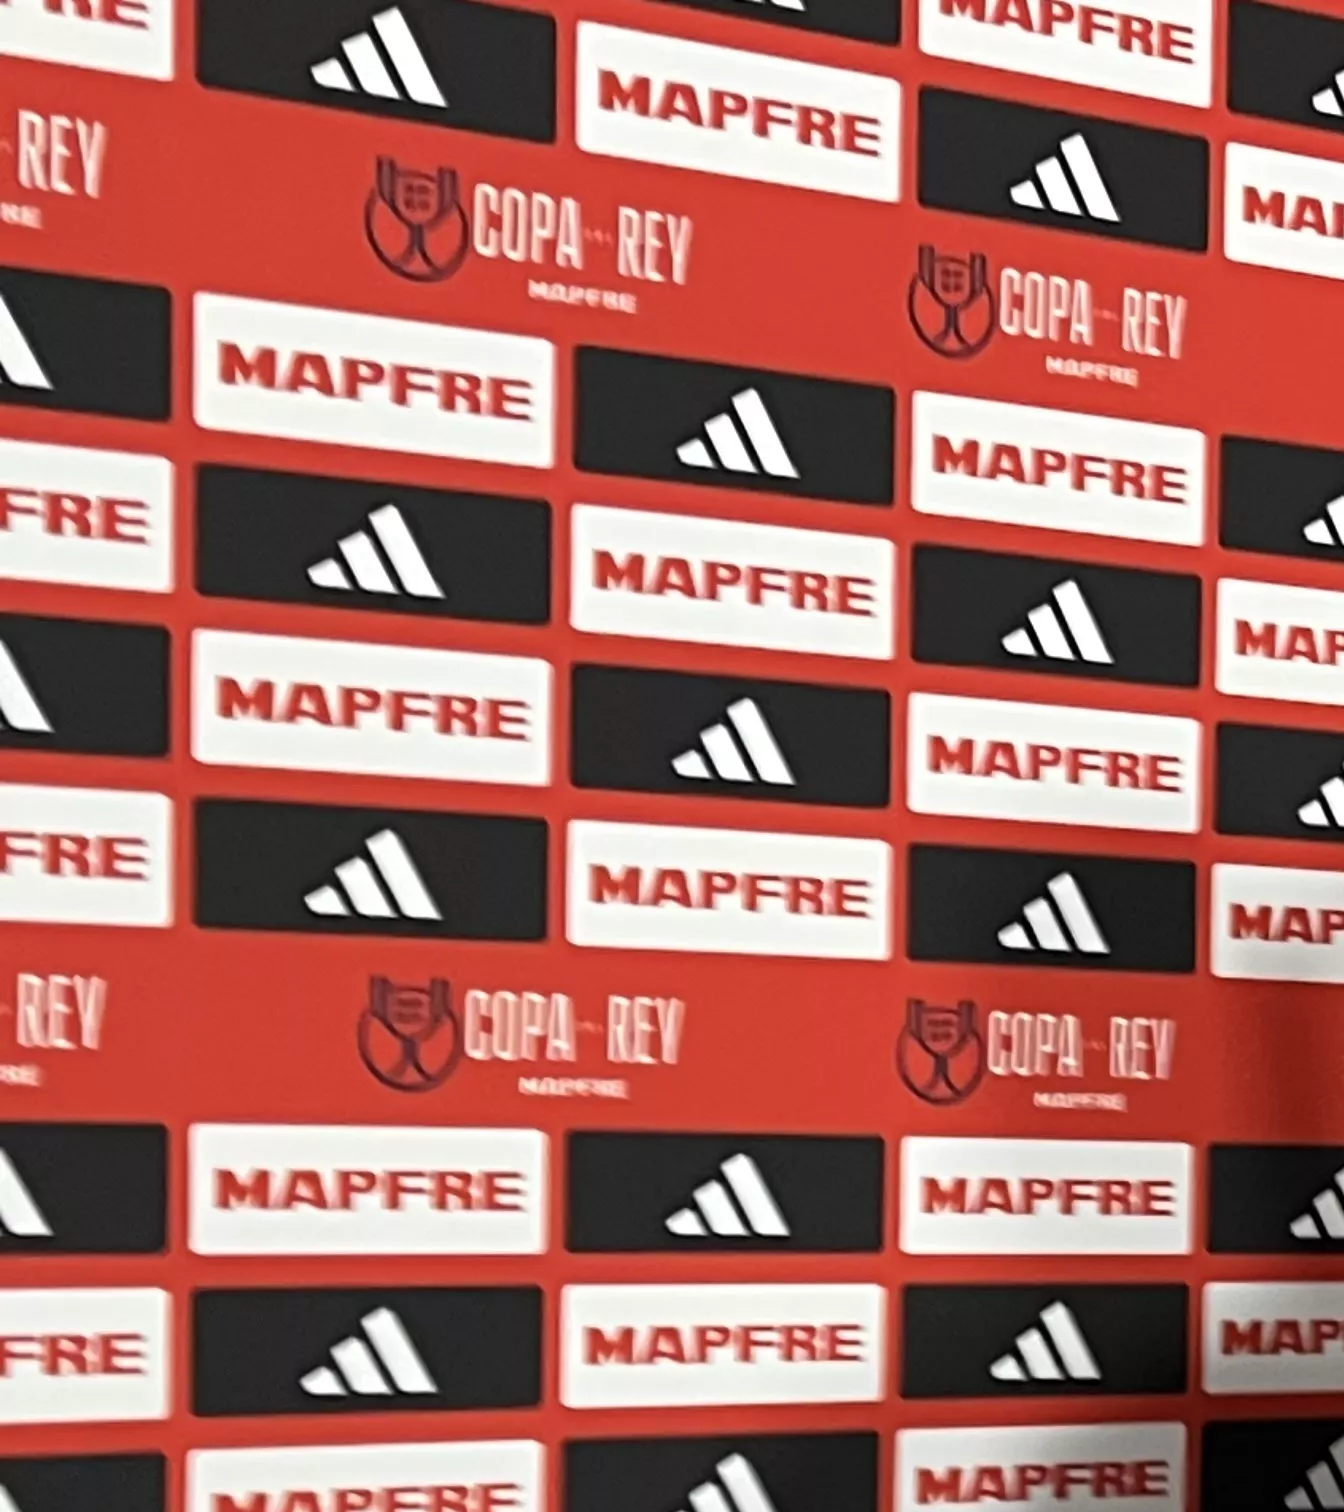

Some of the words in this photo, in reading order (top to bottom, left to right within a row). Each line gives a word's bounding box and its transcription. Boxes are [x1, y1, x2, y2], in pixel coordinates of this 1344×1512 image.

[938, 0, 1194, 64] MAPFRE
[600, 70, 880, 157] MAPFRE
[19, 110, 105, 198] REY
[474, 183, 583, 269] COPA
[618, 206, 692, 285] REY
[528, 280, 636, 313] MAPFRE
[1000, 267, 1092, 345] COPA
[1122, 287, 1186, 359] REY
[219, 342, 531, 421] MAPFRE
[1046, 356, 1138, 387] MAPFRE
[933, 435, 1186, 504] MAPFRE
[0, 487, 147, 544] FRE
[594, 550, 873, 616] MAPFRE
[218, 677, 527, 741] MAPFRE
[929, 736, 1181, 793] MAPFRE
[0, 831, 146, 880] FRE
[590, 865, 868, 918] MAPFRE
[17, 973, 106, 1049] REY
[465, 989, 575, 1061] COPA
[607, 995, 684, 1064] REY
[987, 1011, 1082, 1076] COPA
[1110, 1017, 1174, 1080] REY
[216, 1169, 522, 1211] MAPFRE
[923, 1178, 1174, 1216] MAPFRE
[0, 1334, 143, 1377] FRE
[585, 1324, 862, 1365] MAPFRE
[918, 1461, 1169, 1504] MAPFRE
